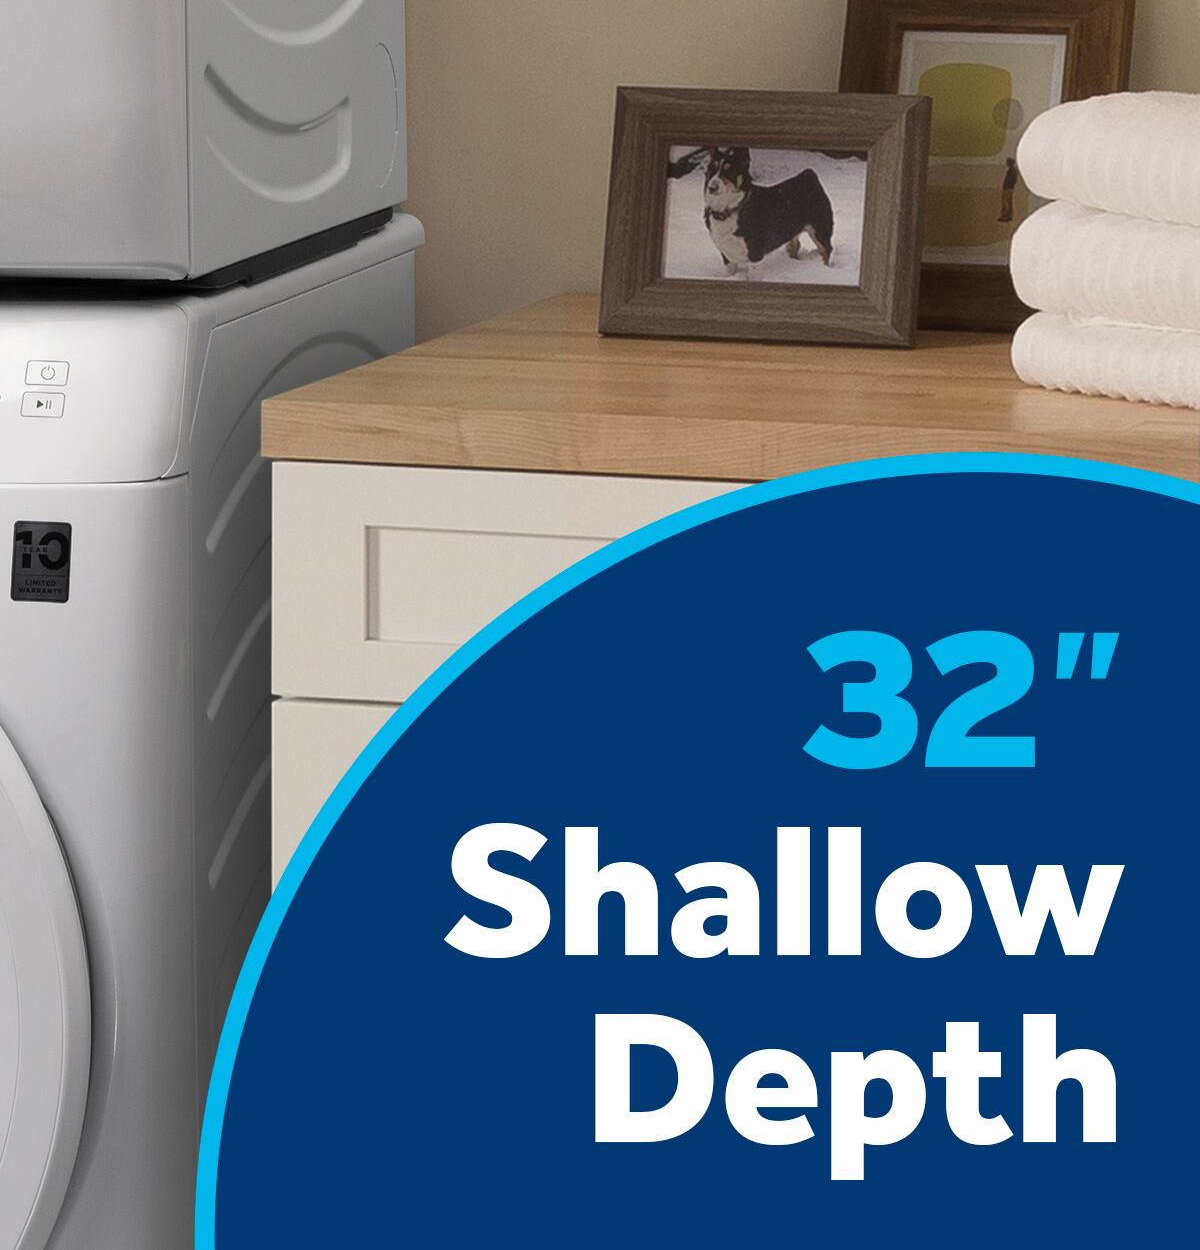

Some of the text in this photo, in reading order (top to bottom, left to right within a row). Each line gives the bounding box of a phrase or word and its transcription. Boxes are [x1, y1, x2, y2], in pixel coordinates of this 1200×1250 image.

[15, 530, 69, 570] 10
[25, 579, 57, 587] LIMITED
[18, 587, 61, 595] WARRANTY
